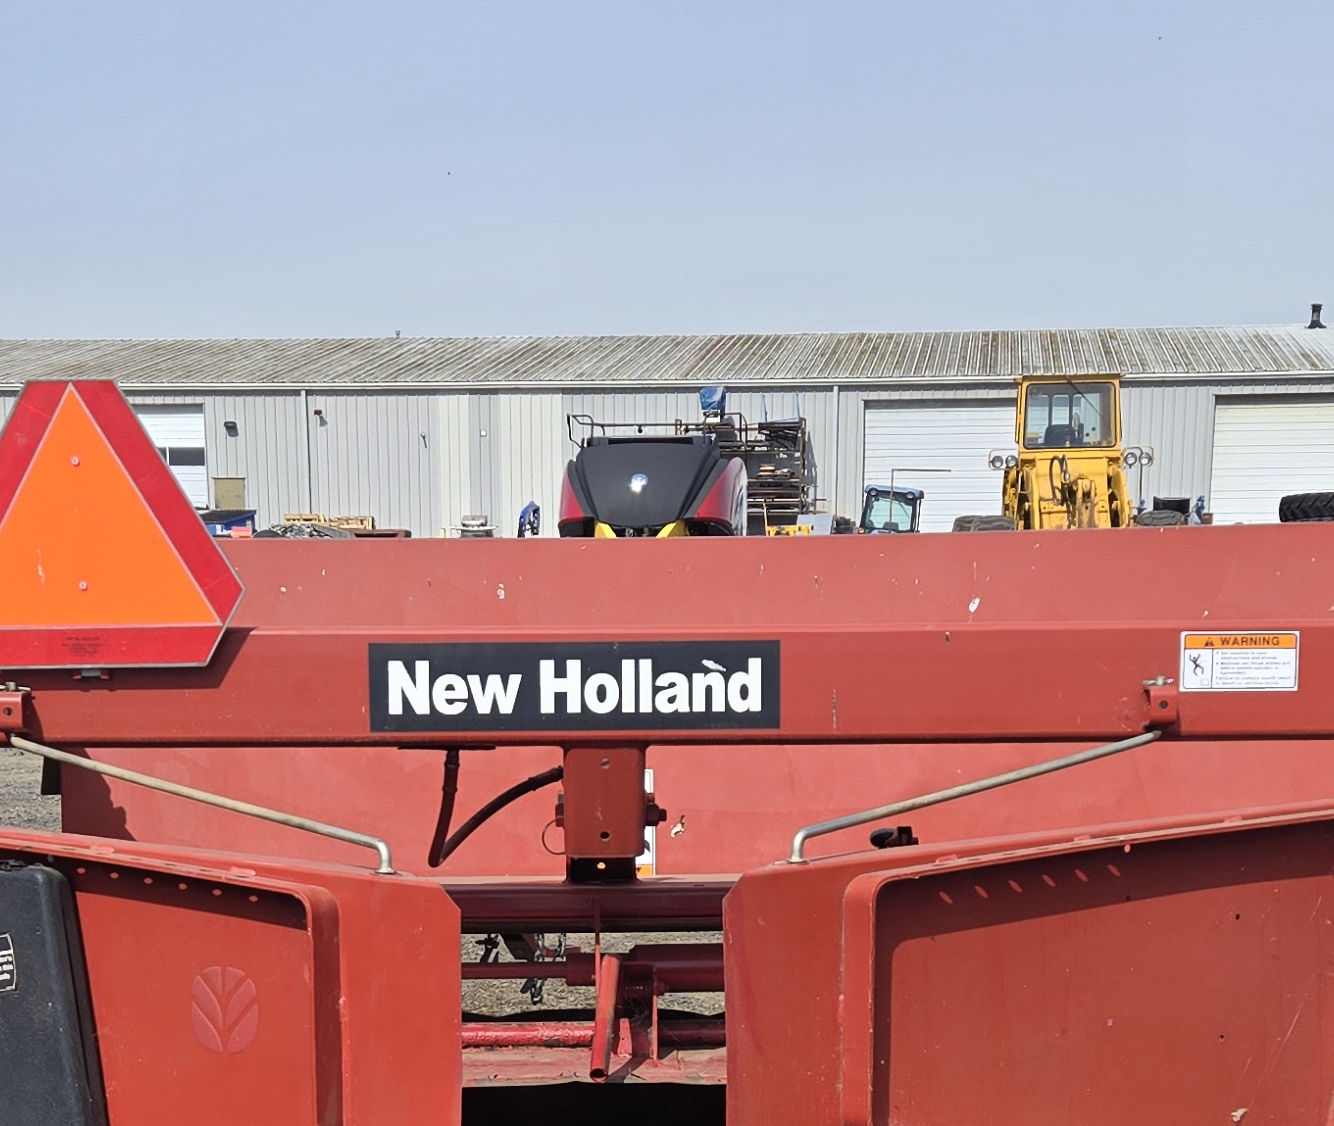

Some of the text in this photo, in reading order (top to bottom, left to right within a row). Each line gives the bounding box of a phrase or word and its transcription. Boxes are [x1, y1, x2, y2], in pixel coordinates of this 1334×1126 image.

[1219, 636, 1280, 647] WARNING
[388, 657, 762, 715] New Holland
